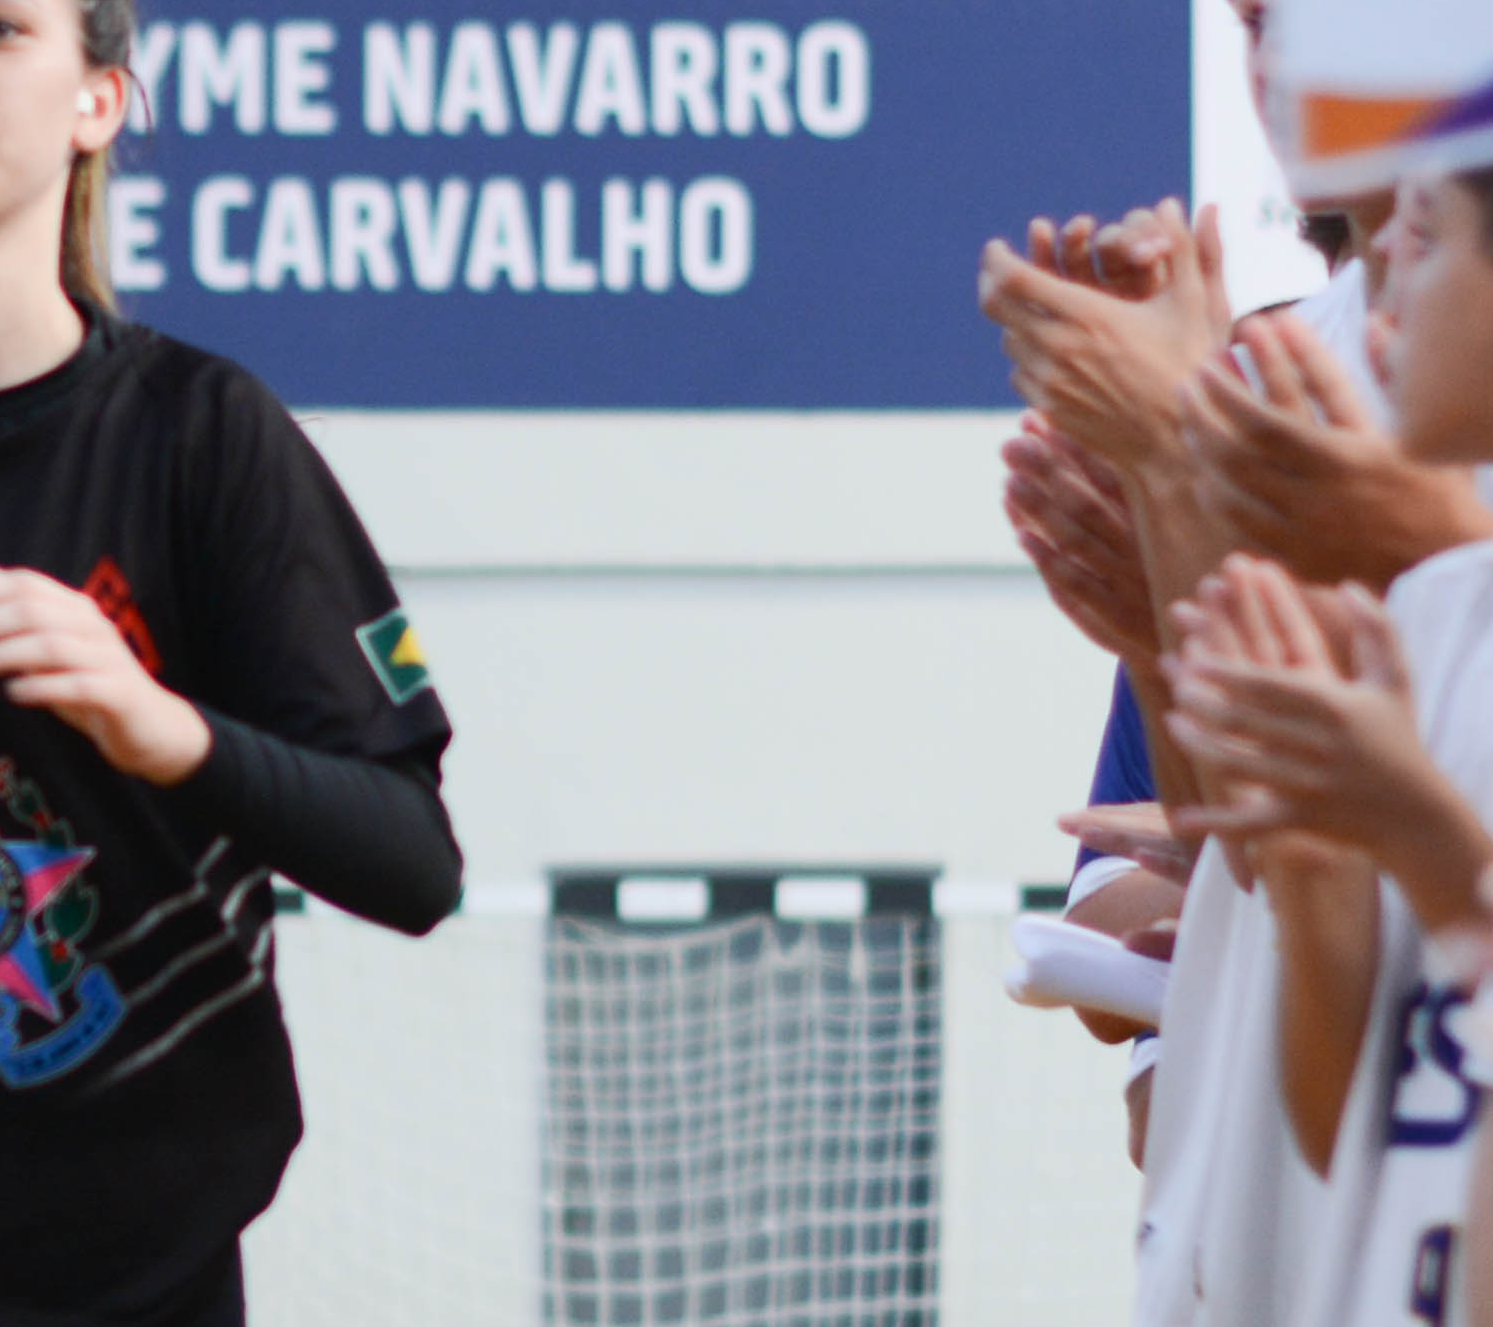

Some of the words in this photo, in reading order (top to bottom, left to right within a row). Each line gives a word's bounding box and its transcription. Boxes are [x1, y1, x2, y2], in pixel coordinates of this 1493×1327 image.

[125, 19, 336, 135] YME
[363, 19, 871, 139] NAVARRO
[110, 175, 167, 293] E
[190, 175, 755, 295] CARVALHO
